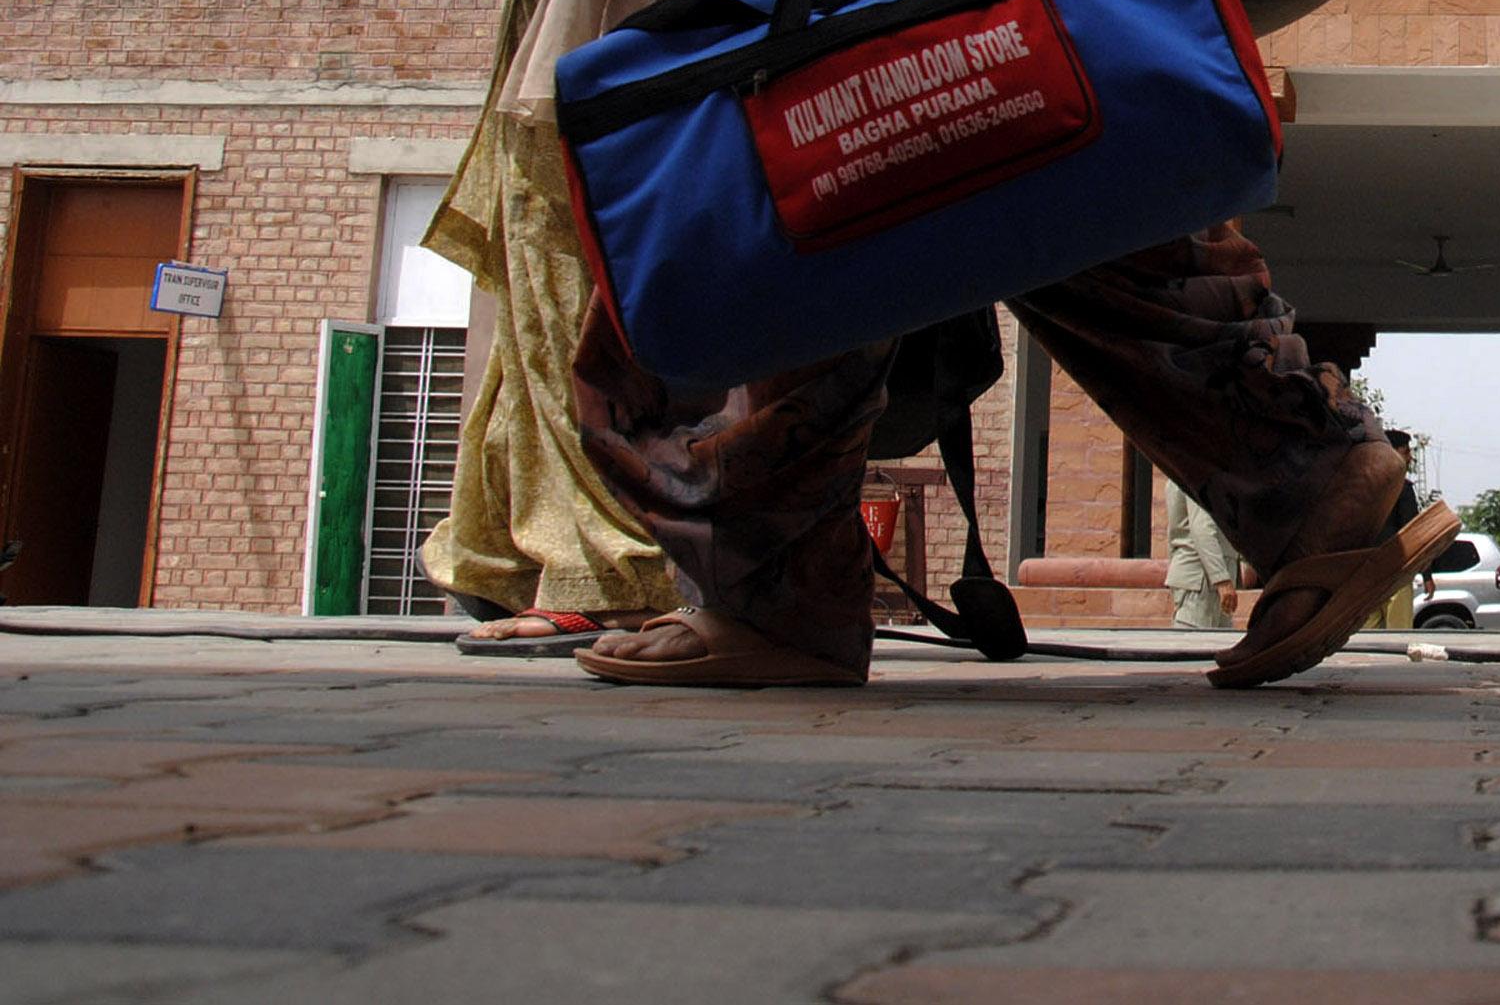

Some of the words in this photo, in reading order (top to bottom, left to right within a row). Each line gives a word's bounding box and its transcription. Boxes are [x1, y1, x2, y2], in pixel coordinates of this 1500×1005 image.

[785, 74, 870, 148] KULWANT
[864, 39, 969, 111] HANDLOOM
[965, 20, 1030, 72] STORE
[838, 110, 911, 155] BAGHA
[910, 76, 998, 125] PURANA
[811, 171, 839, 201] (M)
